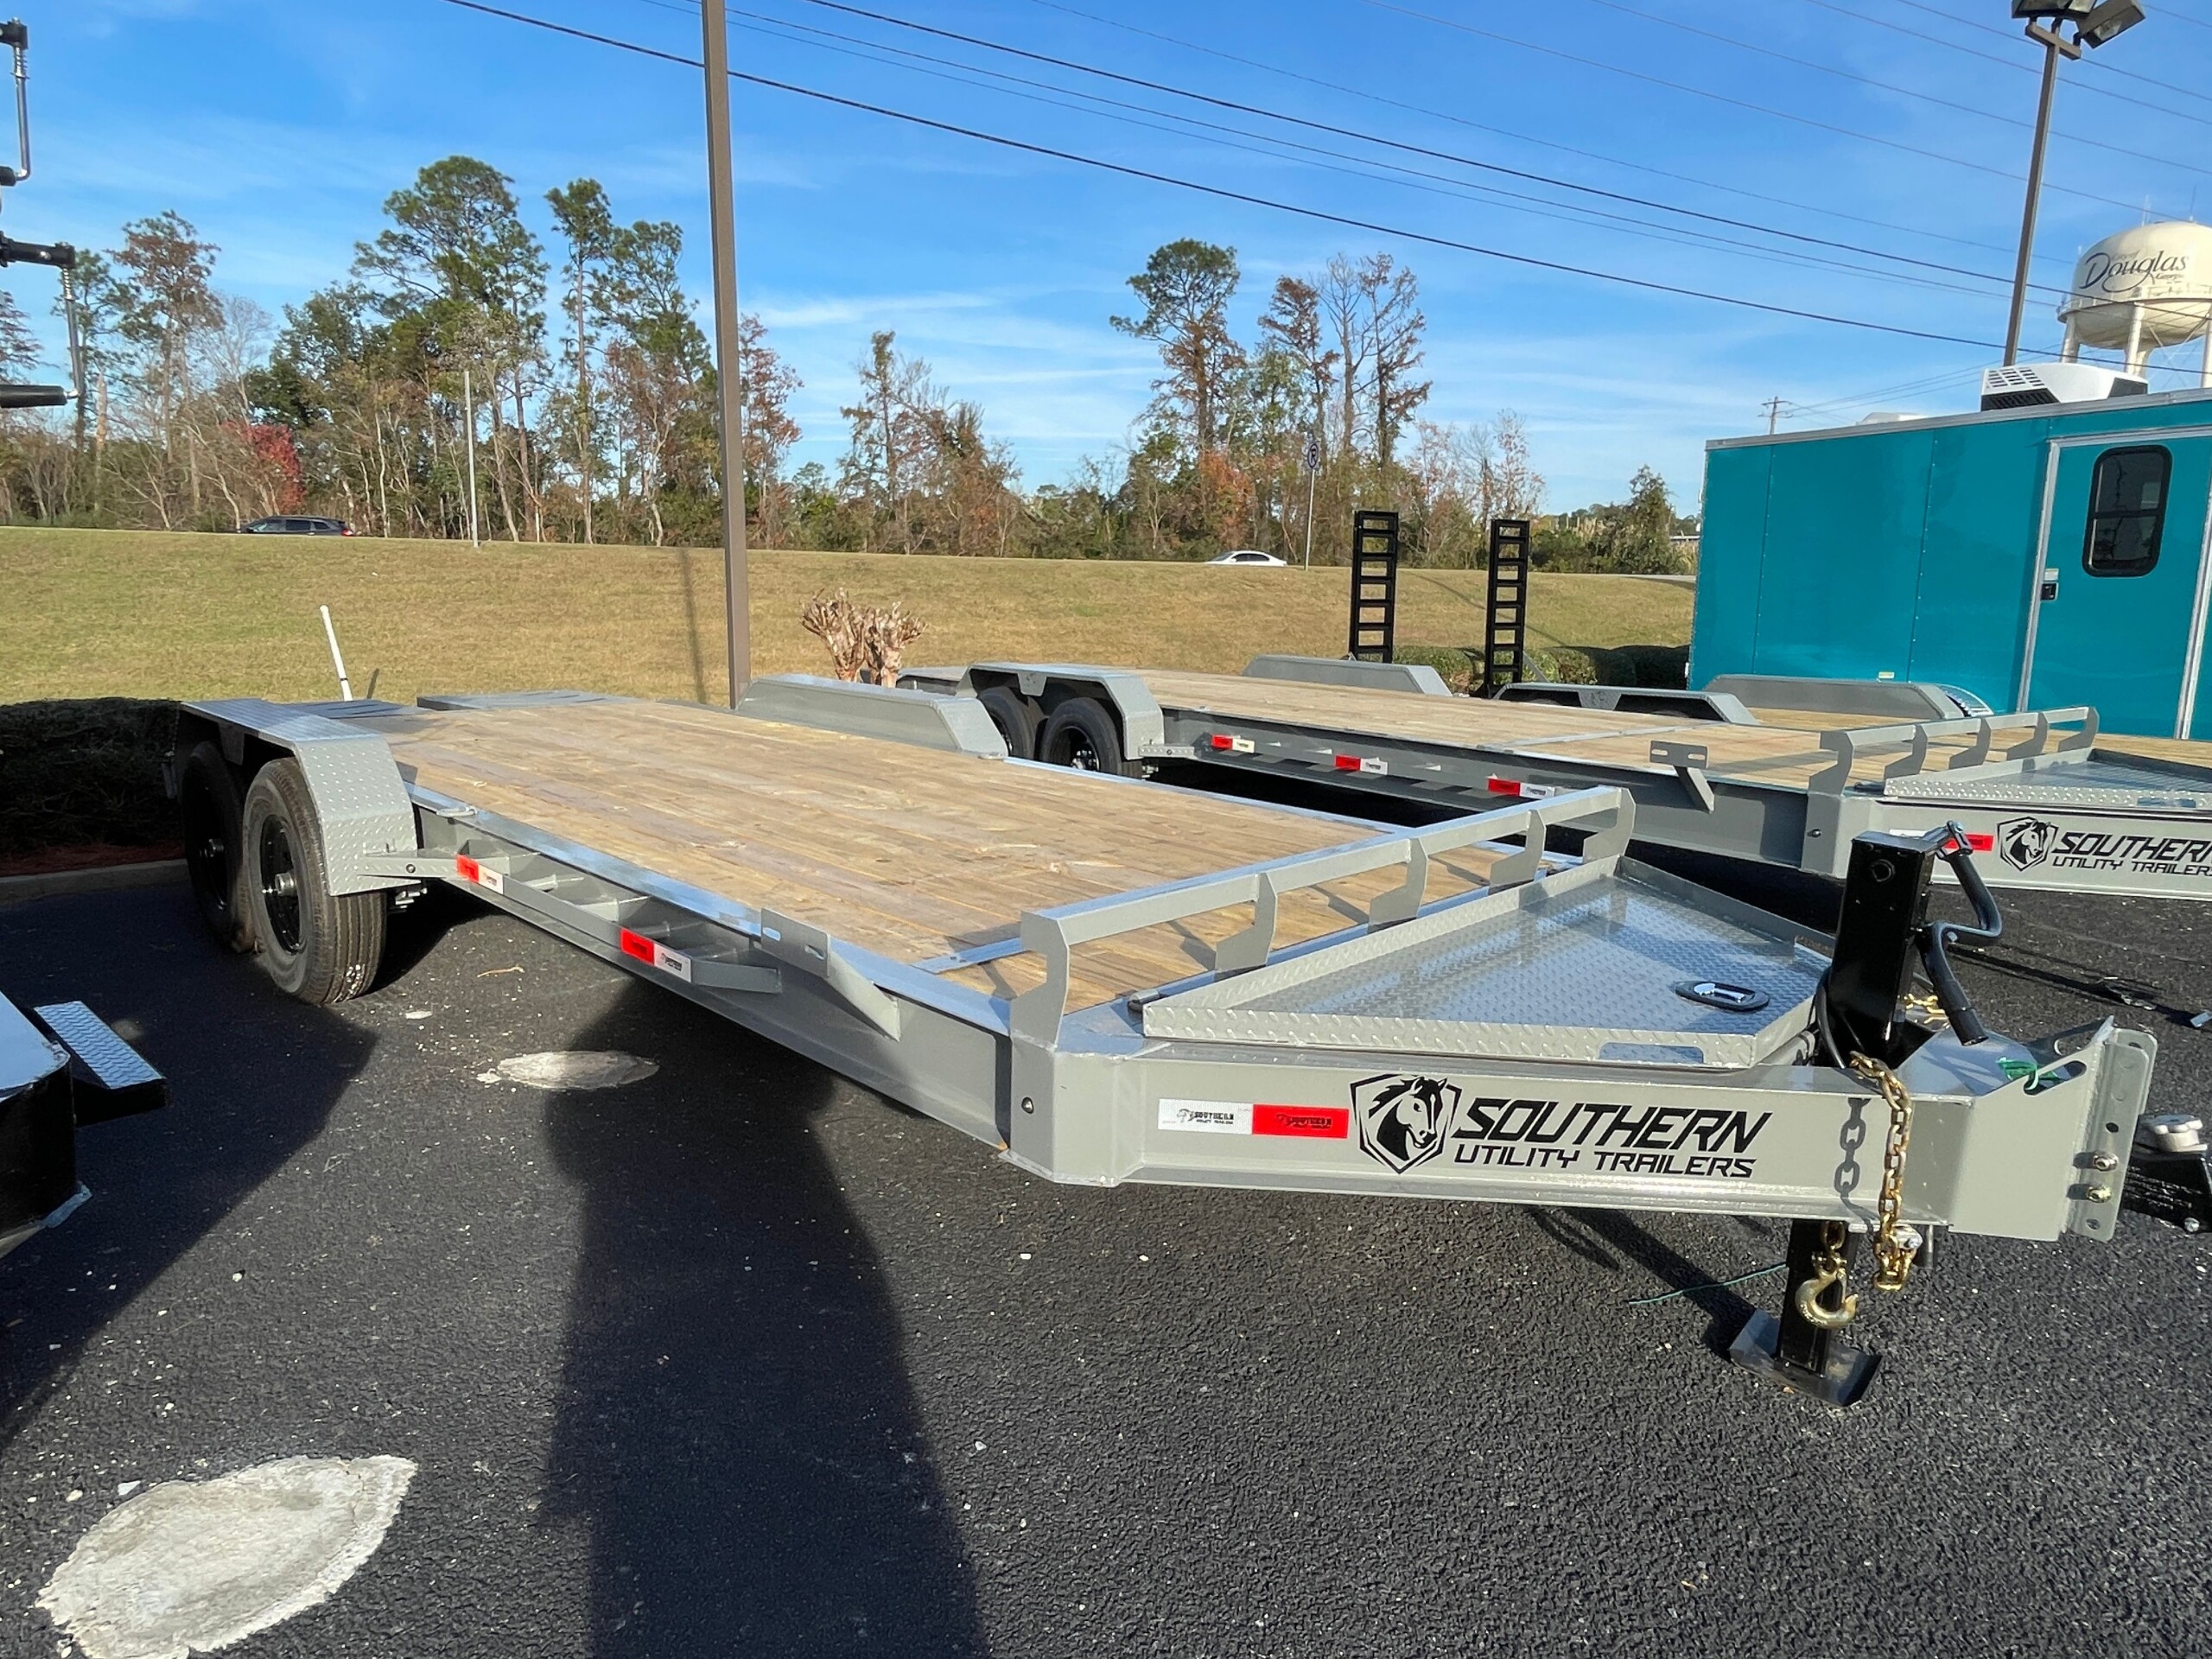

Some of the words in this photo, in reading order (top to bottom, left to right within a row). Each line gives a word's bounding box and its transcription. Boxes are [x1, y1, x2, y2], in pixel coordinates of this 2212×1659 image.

[2079, 251, 2187, 293] Douglas
[2052, 856, 2123, 871] UTILITY
[2131, 861, 2212, 876] TRAILER
[1451, 1097, 1773, 1154] SOUTHERN
[1454, 1143, 1580, 1169] UTILITY
[1593, 1151, 1758, 1179] TRAILERS
